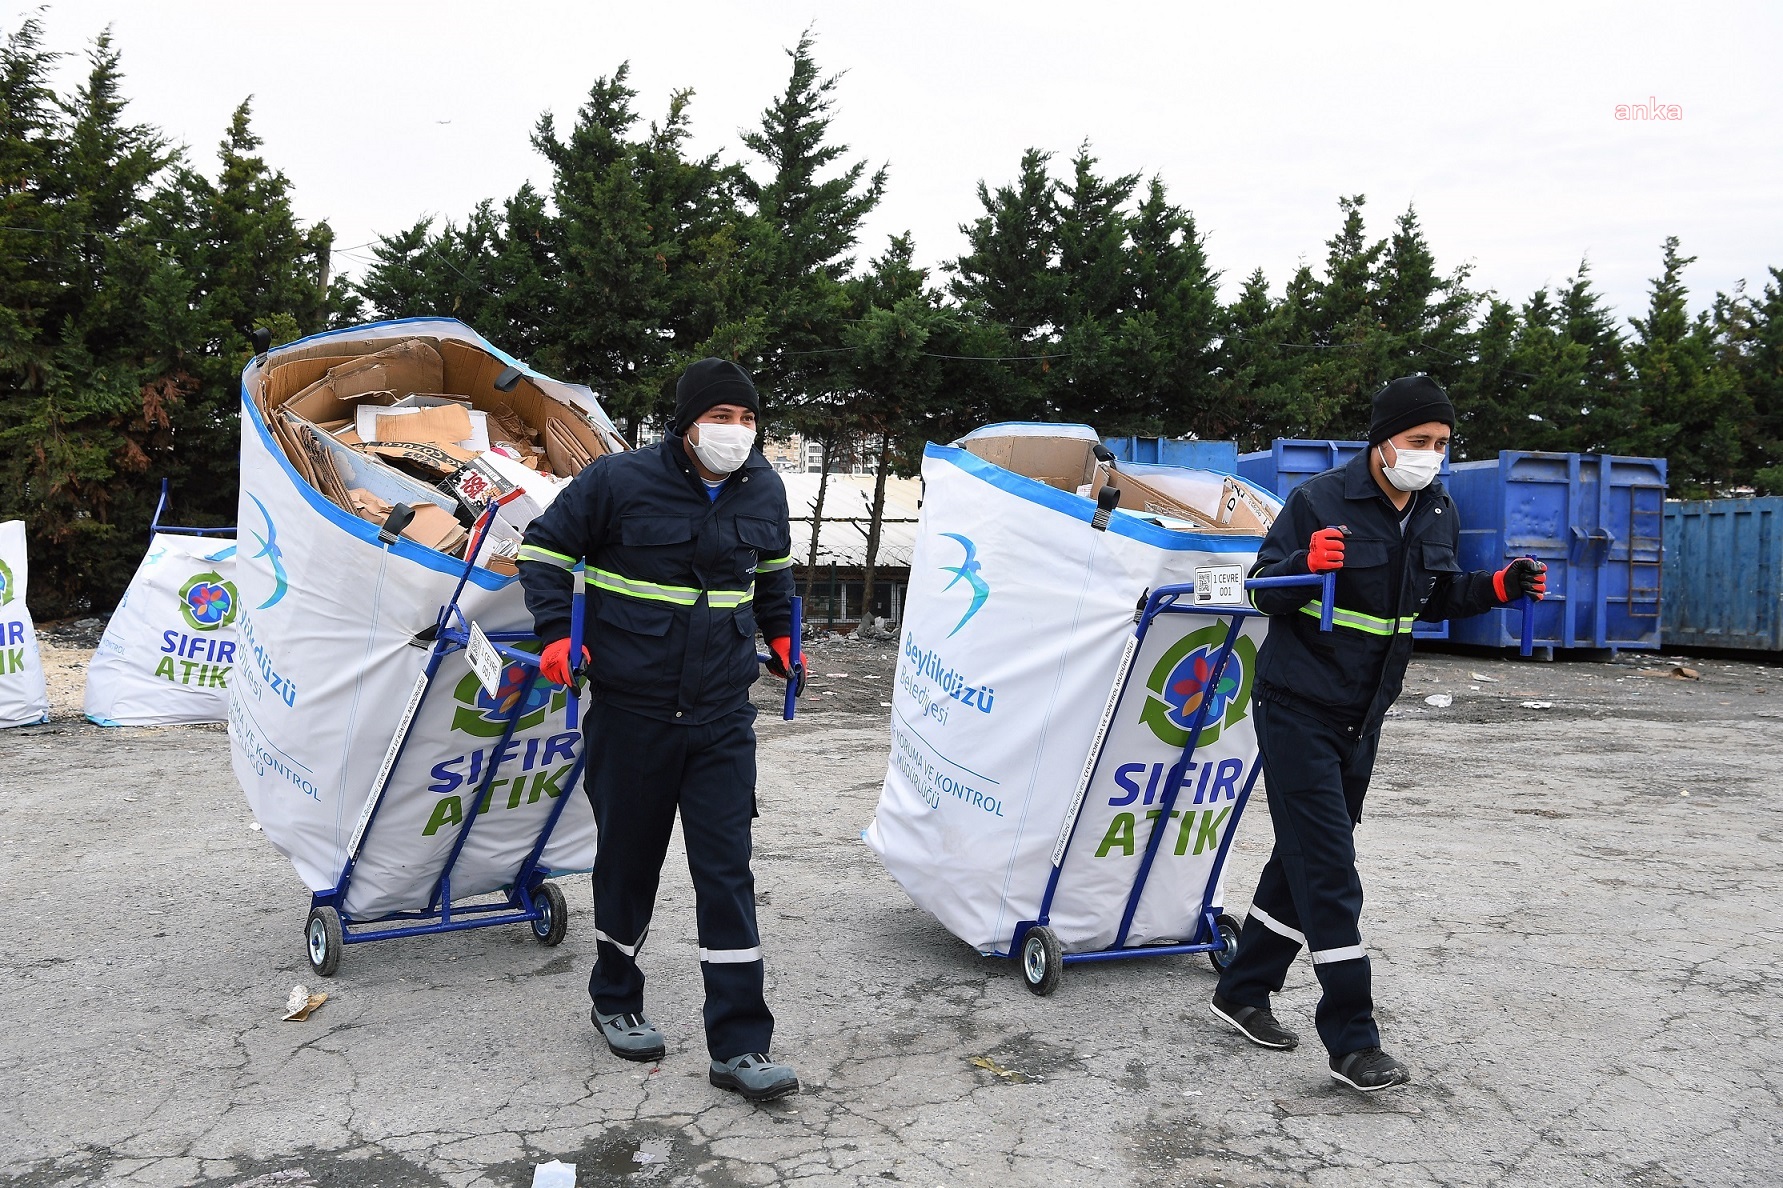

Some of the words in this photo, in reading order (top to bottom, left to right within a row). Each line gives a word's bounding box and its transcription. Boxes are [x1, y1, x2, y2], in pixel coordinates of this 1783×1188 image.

[1213, 574, 1217, 583] 1
[1218, 573, 1239, 583] CEVRE
[1220, 587, 1232, 596] 001
[154, 655, 233, 688] ATIK
[160, 630, 236, 663] SIFIR
[905, 631, 994, 714] Beylikdüzü
[900, 665, 949, 726] Belediyesi
[1105, 688, 1119, 719] KONTROL
[256, 743, 321, 803] KONTROL
[428, 731, 582, 793] SIFIR
[896, 728, 923, 771] KORUMA
[924, 760, 935, 781] VE
[934, 771, 1004, 818] KONTROL
[1108, 758, 1243, 806] SIFIR
[421, 763, 575, 837] ATIK
[1094, 806, 1232, 858] ATIK
